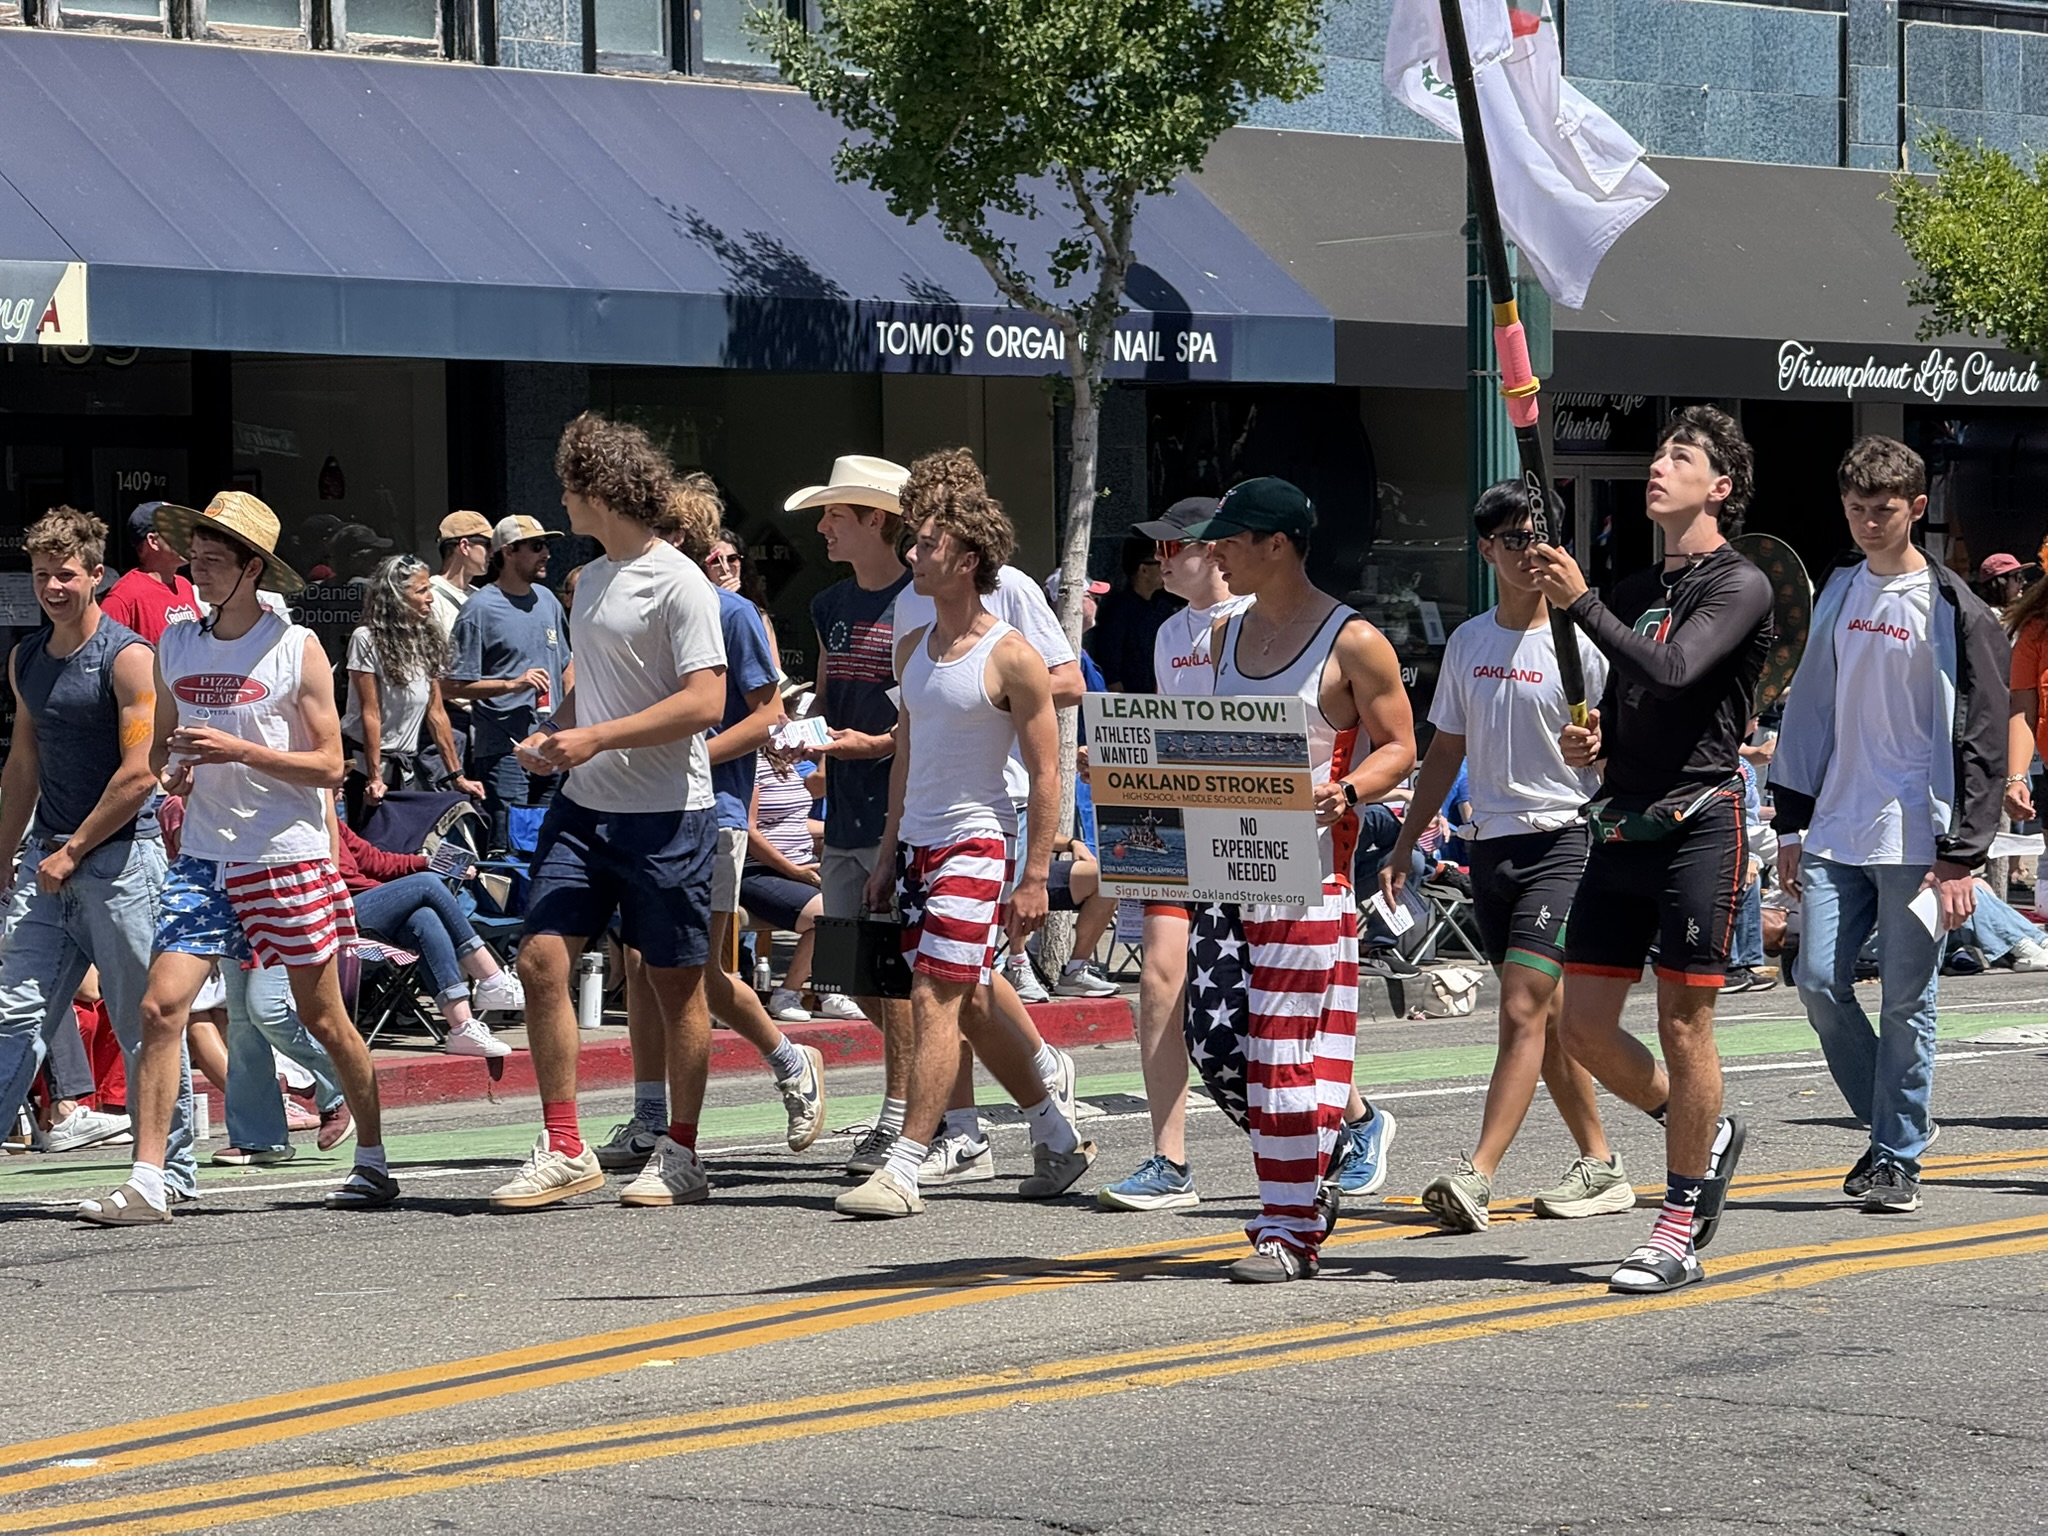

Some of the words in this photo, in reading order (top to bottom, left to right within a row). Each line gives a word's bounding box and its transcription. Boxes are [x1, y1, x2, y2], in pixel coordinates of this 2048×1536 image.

[876, 320, 974, 357] TOMO'S
[985, 324, 1088, 361] ORGA
[1114, 330, 1165, 362] NAIL
[1176, 331, 1218, 363] SPA
[1778, 340, 1914, 399] Triumphant
[1913, 348, 1959, 402] Life
[1961, 351, 2040, 395] Church
[1553, 410, 1612, 441] Church
[116, 471, 151, 491] 1409
[1525, 469, 1549, 543] CROKER
[306, 584, 362, 601] Daniel
[200, 676, 241, 687] PIZZA
[194, 693, 243, 704] HEART
[1101, 698, 1178, 720] LEARN
[1182, 700, 1215, 721] TO
[1221, 701, 1287, 723] ROW!
[1095, 725, 1151, 745] ATHLETES
[1100, 746, 1149, 765] WANTED
[1108, 772, 1201, 792] OAKLAND
[1205, 776, 1295, 795] STROKES
[1122, 792, 1143, 801] HIGH
[1143, 793, 1175, 803] SCHOOL
[1182, 794, 1213, 804] MIDDLE
[1212, 795, 1247, 805] SCHOOL
[1248, 797, 1283, 806] ROWING
[1240, 816, 1258, 836] NO
[1212, 838, 1290, 860] EXPERIENCE
[1116, 865, 1147, 873] NATIONAL
[1147, 866, 1186, 875] CHAMPIONS
[1227, 861, 1277, 882] NEEDED
[1115, 885, 1139, 898] Sign
[1144, 886, 1159, 899] Up
[1162, 887, 1190, 899] Now:
[1192, 888, 1305, 906] OaklandStrokes.org
